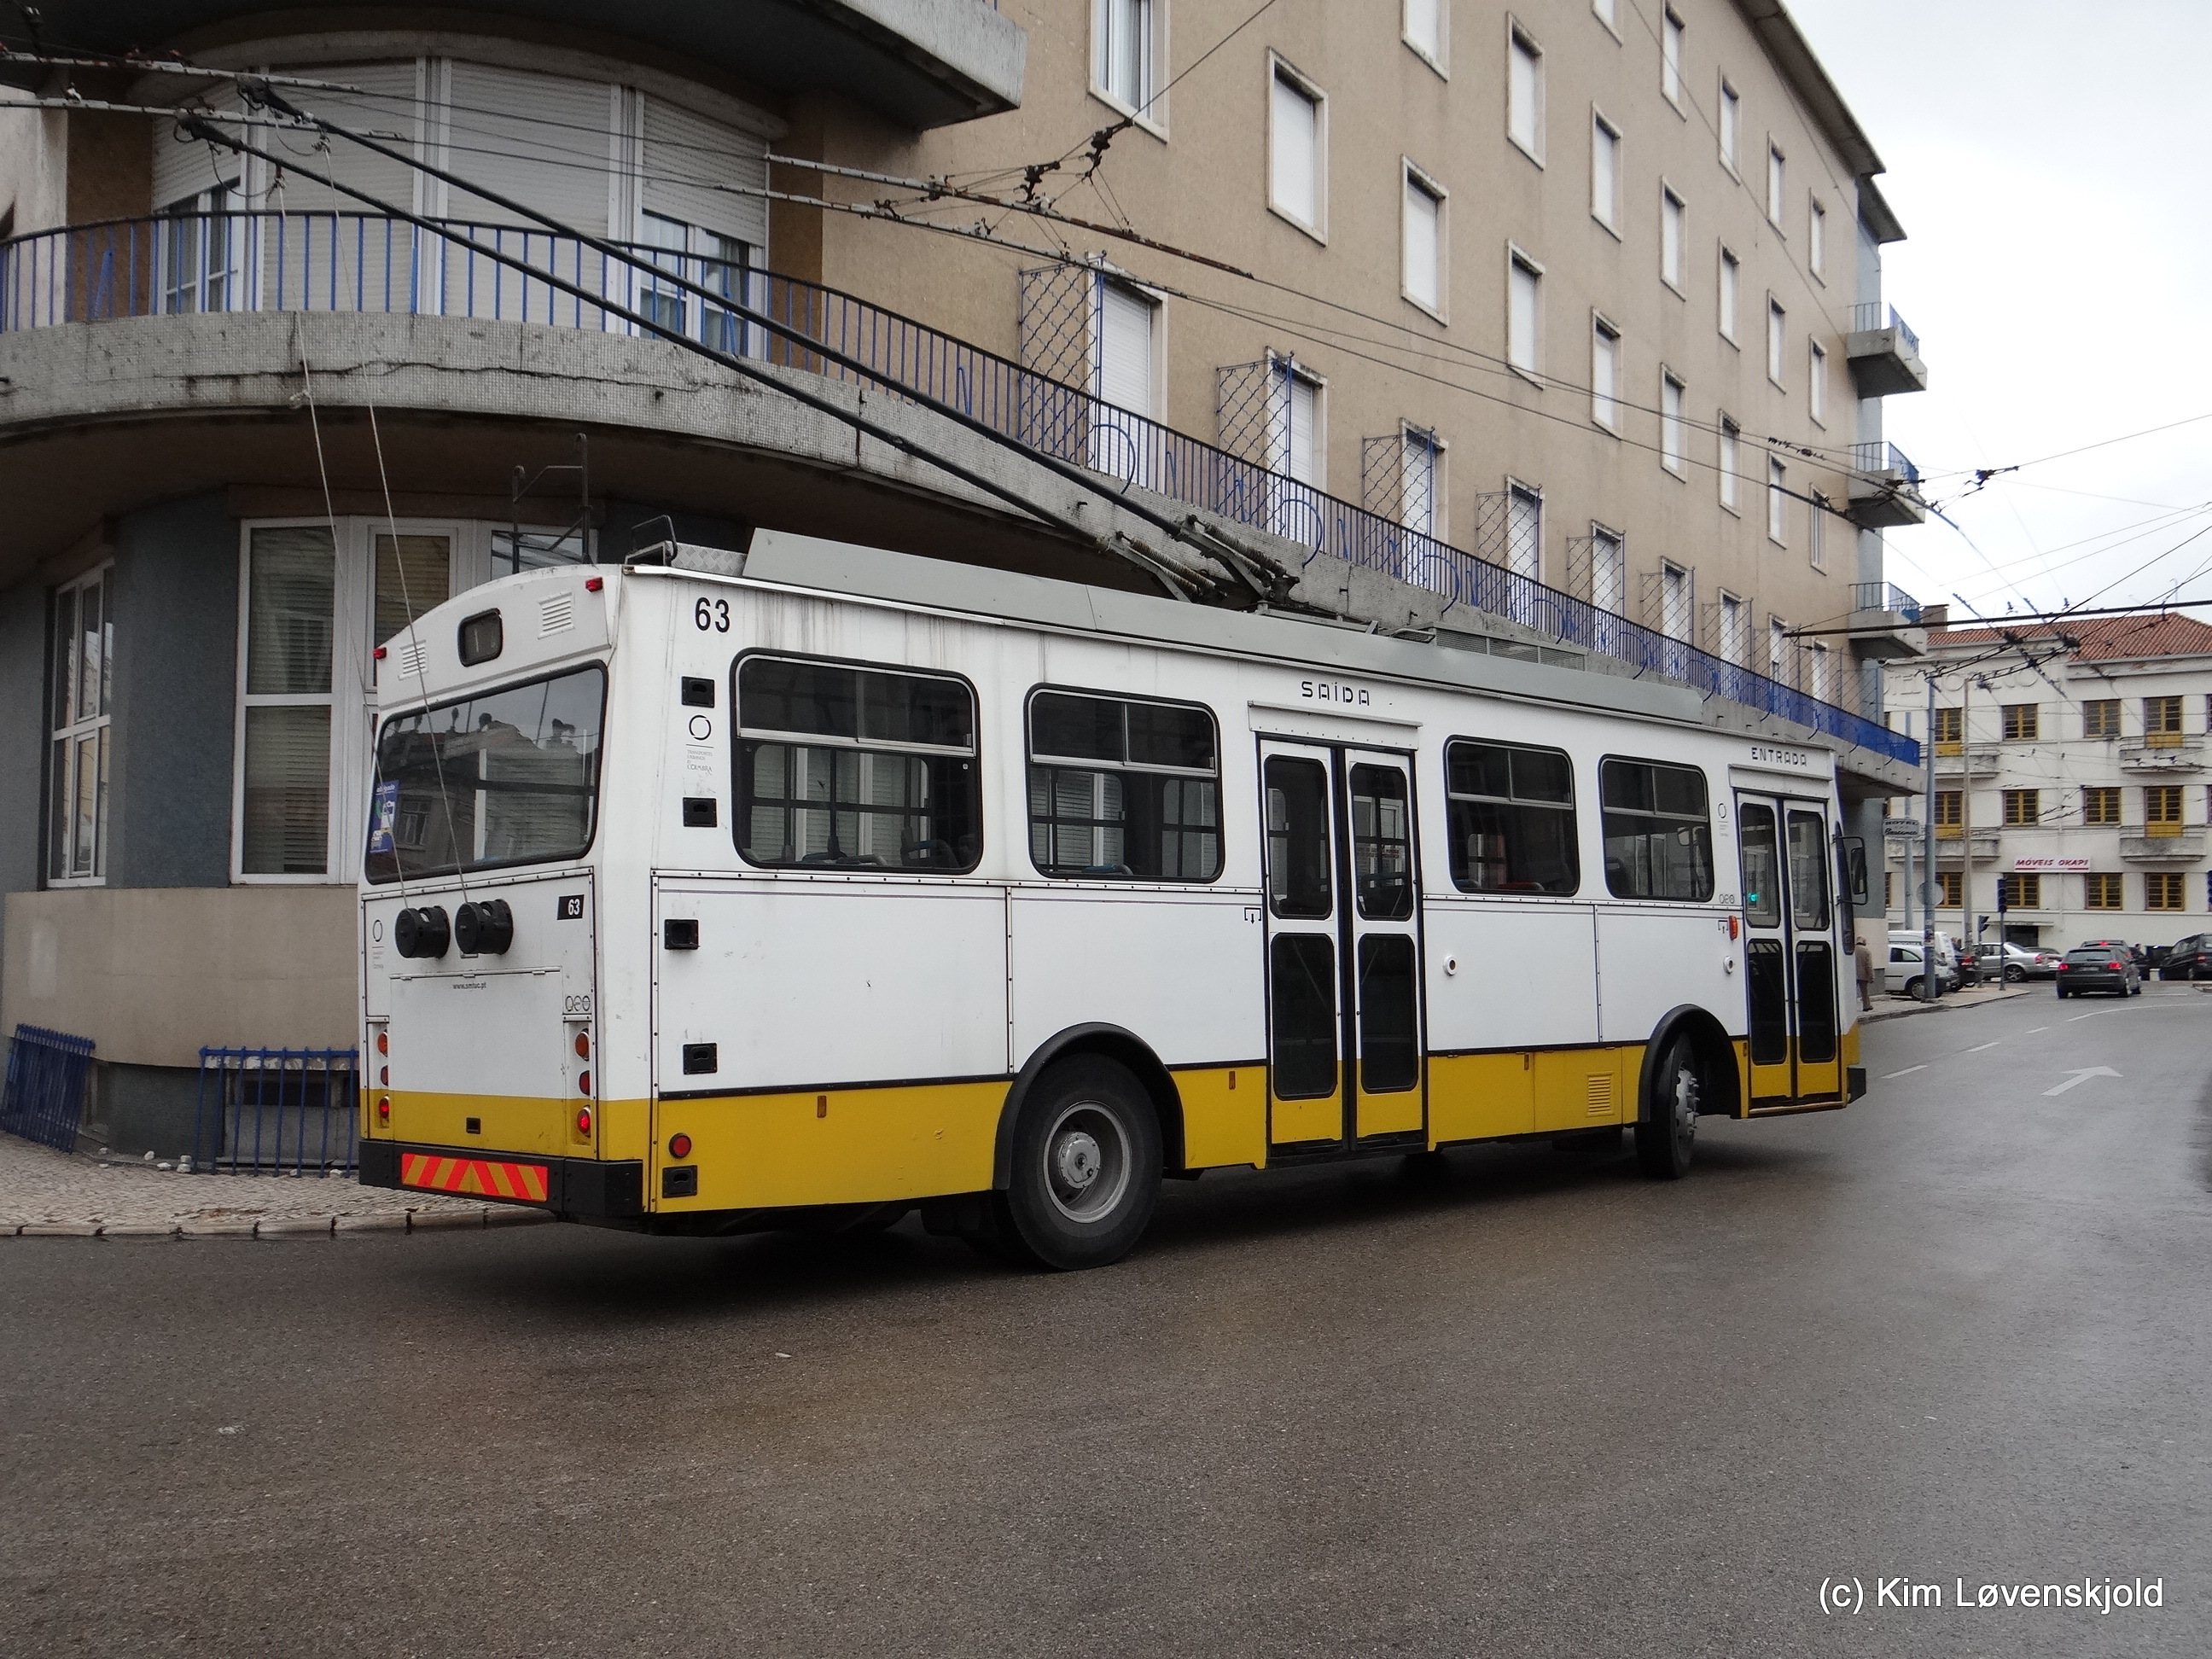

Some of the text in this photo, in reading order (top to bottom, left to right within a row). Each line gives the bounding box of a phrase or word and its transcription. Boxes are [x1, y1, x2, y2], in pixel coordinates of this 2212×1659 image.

[696, 597, 731, 633] 63
[1301, 681, 1371, 707] SAÍDA
[1750, 747, 1807, 767] ENTRADA
[686, 764, 713, 775] COIMBRA
[2015, 857, 2055, 866] MÓVEIS
[568, 898, 581, 916] 63
